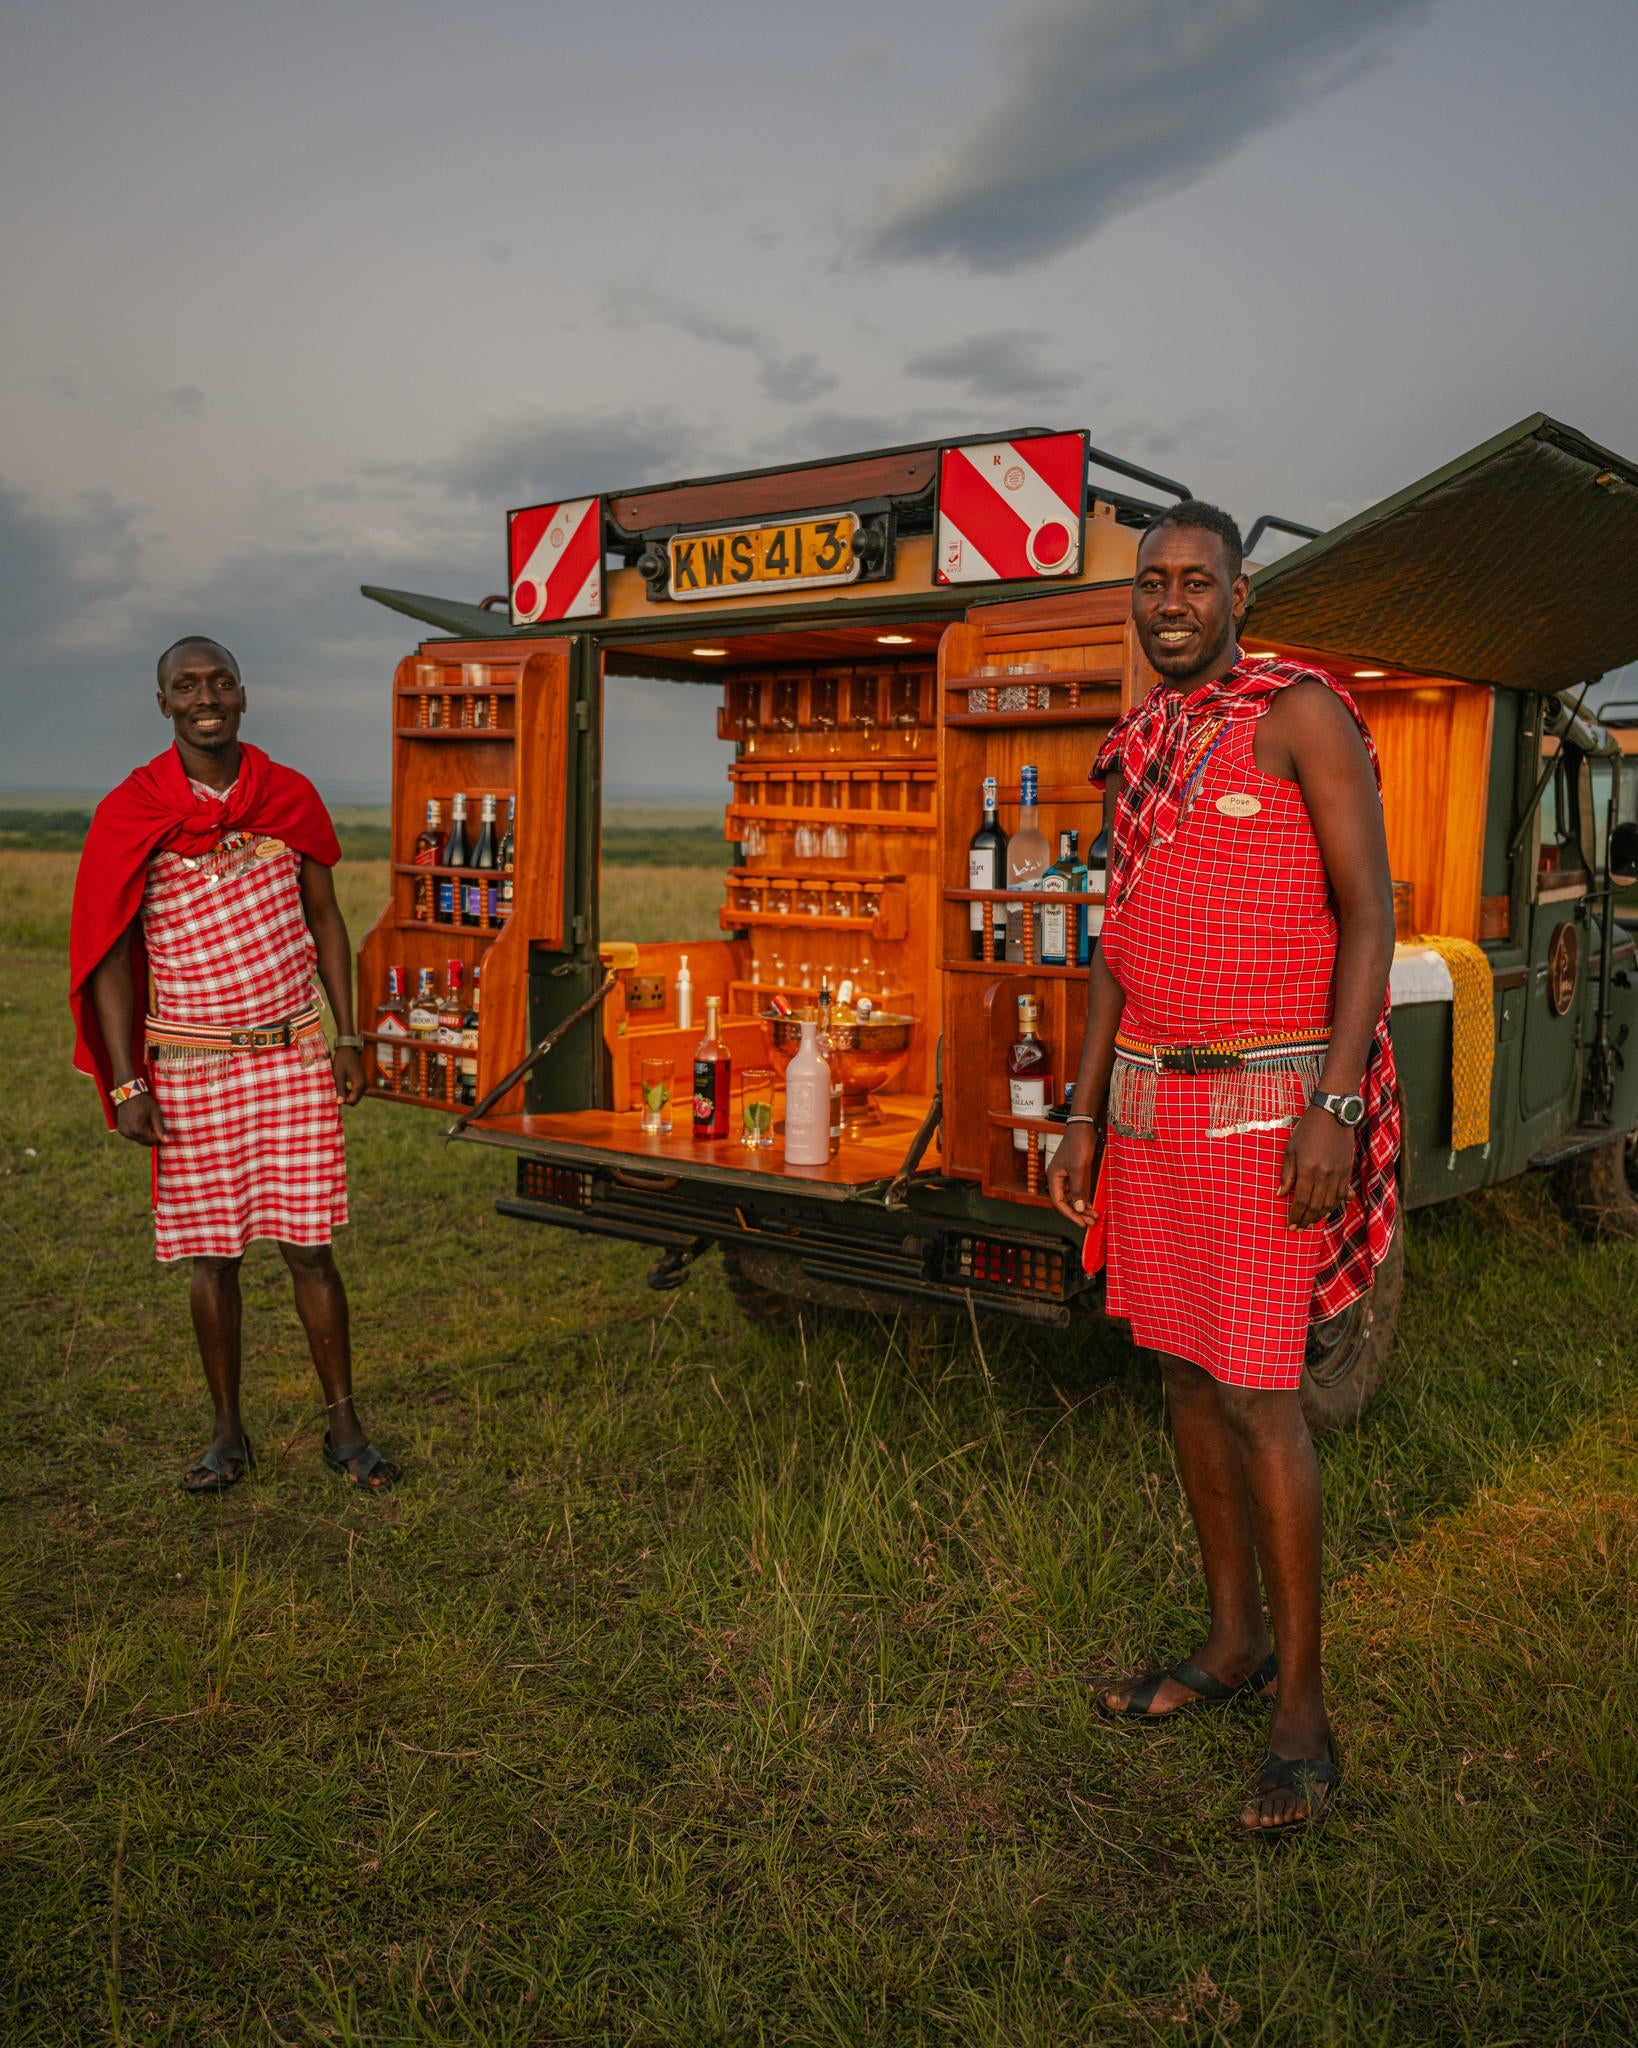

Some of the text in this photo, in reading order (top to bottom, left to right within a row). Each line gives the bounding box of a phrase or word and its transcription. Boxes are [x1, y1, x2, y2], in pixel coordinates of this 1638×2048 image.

[993, 455, 1001, 465] R
[565, 514, 571, 523] L
[675, 522, 842, 588] KWS 413
[1230, 797, 1250, 805] Pose
